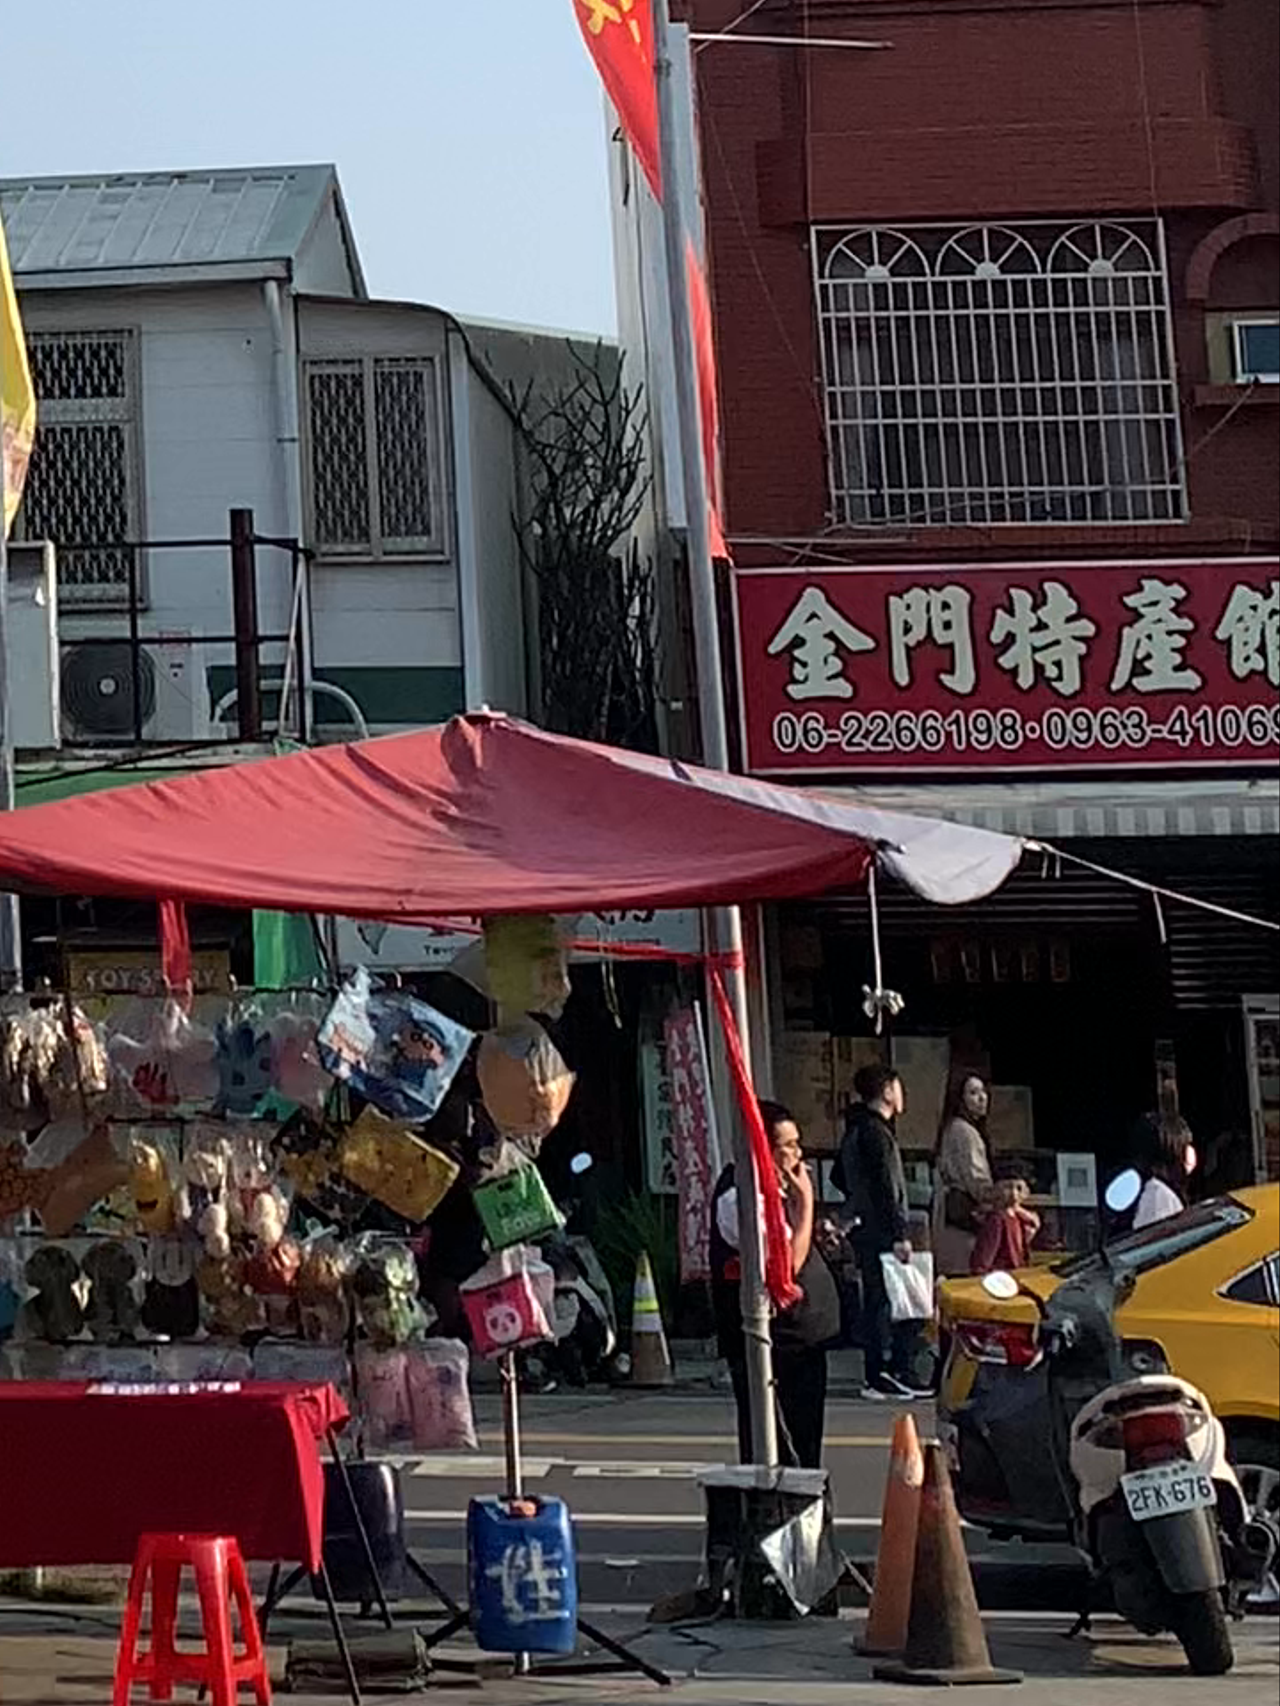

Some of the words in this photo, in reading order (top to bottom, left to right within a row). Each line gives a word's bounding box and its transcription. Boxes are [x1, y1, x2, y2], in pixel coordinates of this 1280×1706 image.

[768, 578, 1280, 702] 金門特產館
